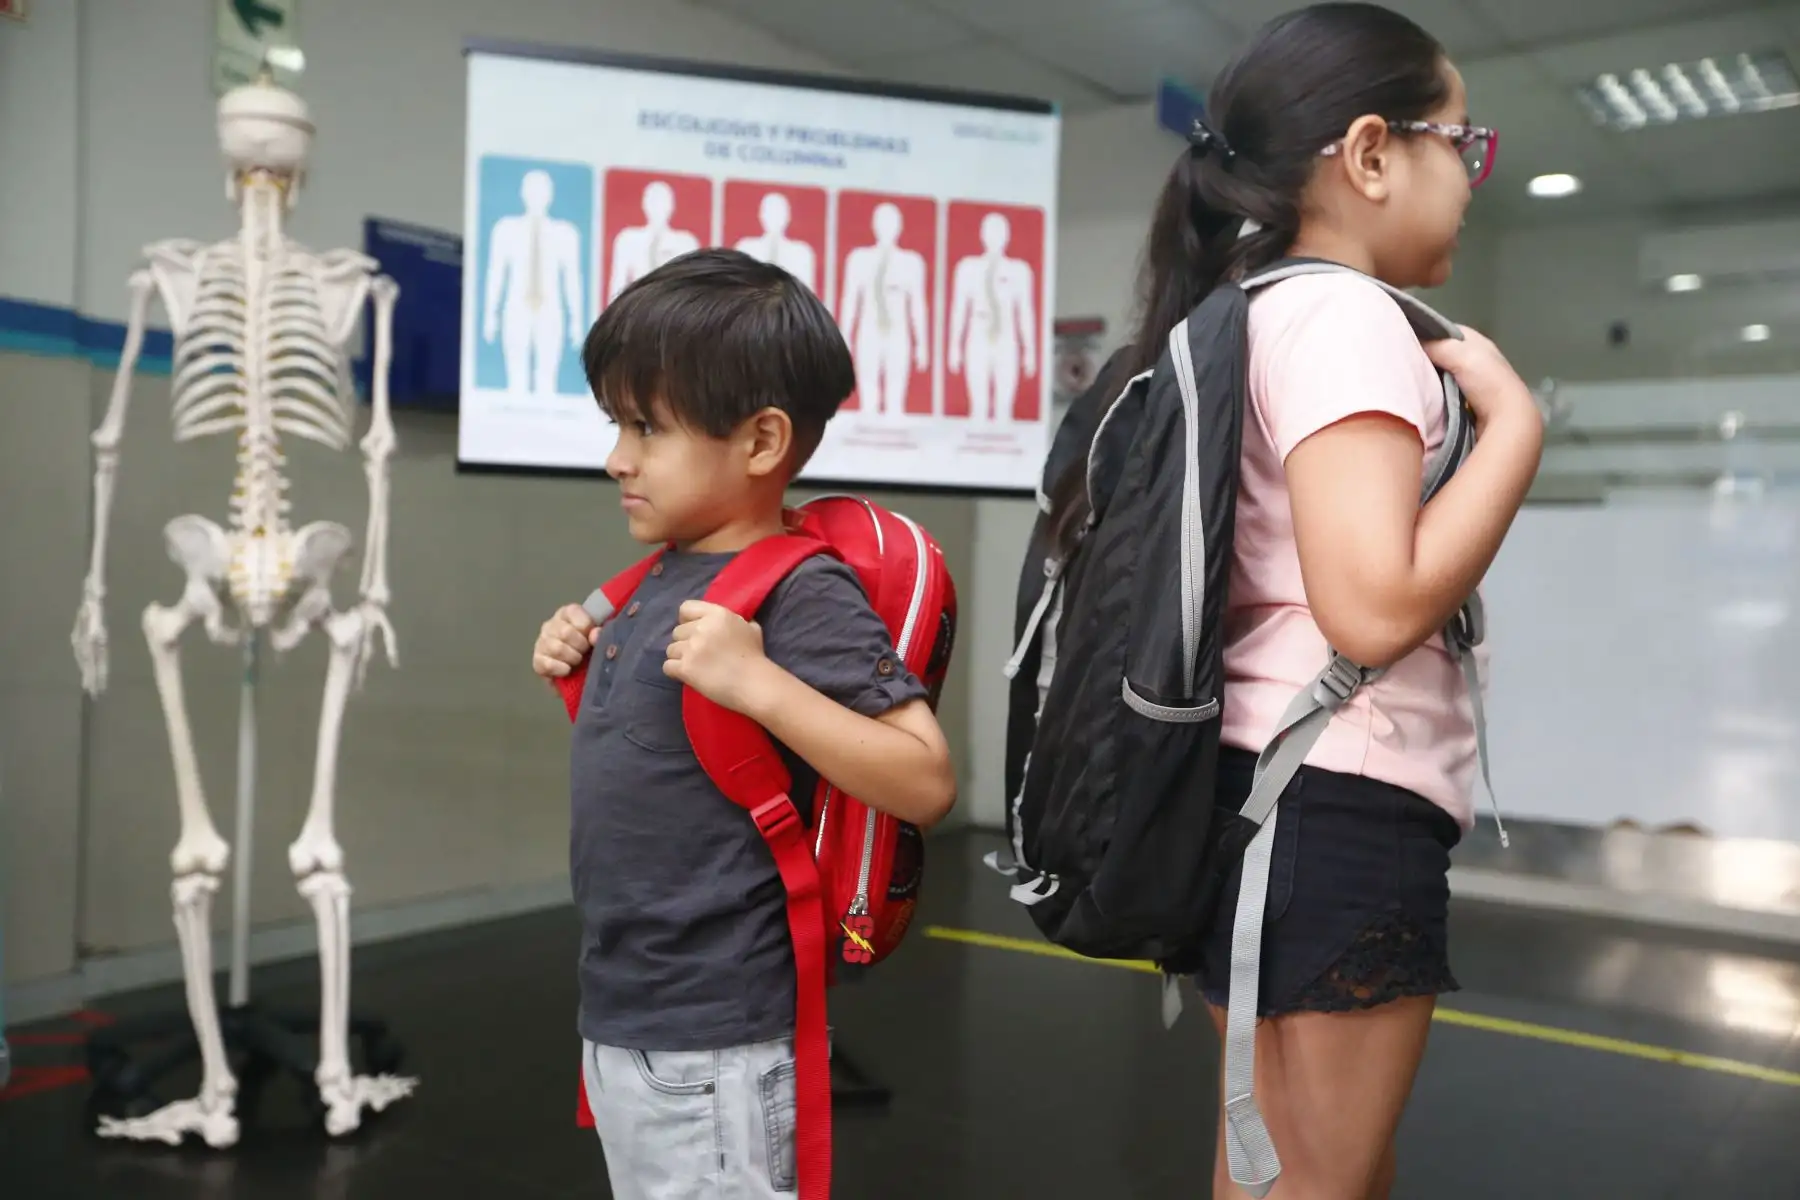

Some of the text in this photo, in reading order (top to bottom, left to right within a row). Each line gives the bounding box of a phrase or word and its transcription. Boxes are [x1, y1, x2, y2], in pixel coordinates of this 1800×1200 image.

[704, 141, 847, 170] DE COLUMNA
[785, 125, 909, 156] PROBLEMAS
